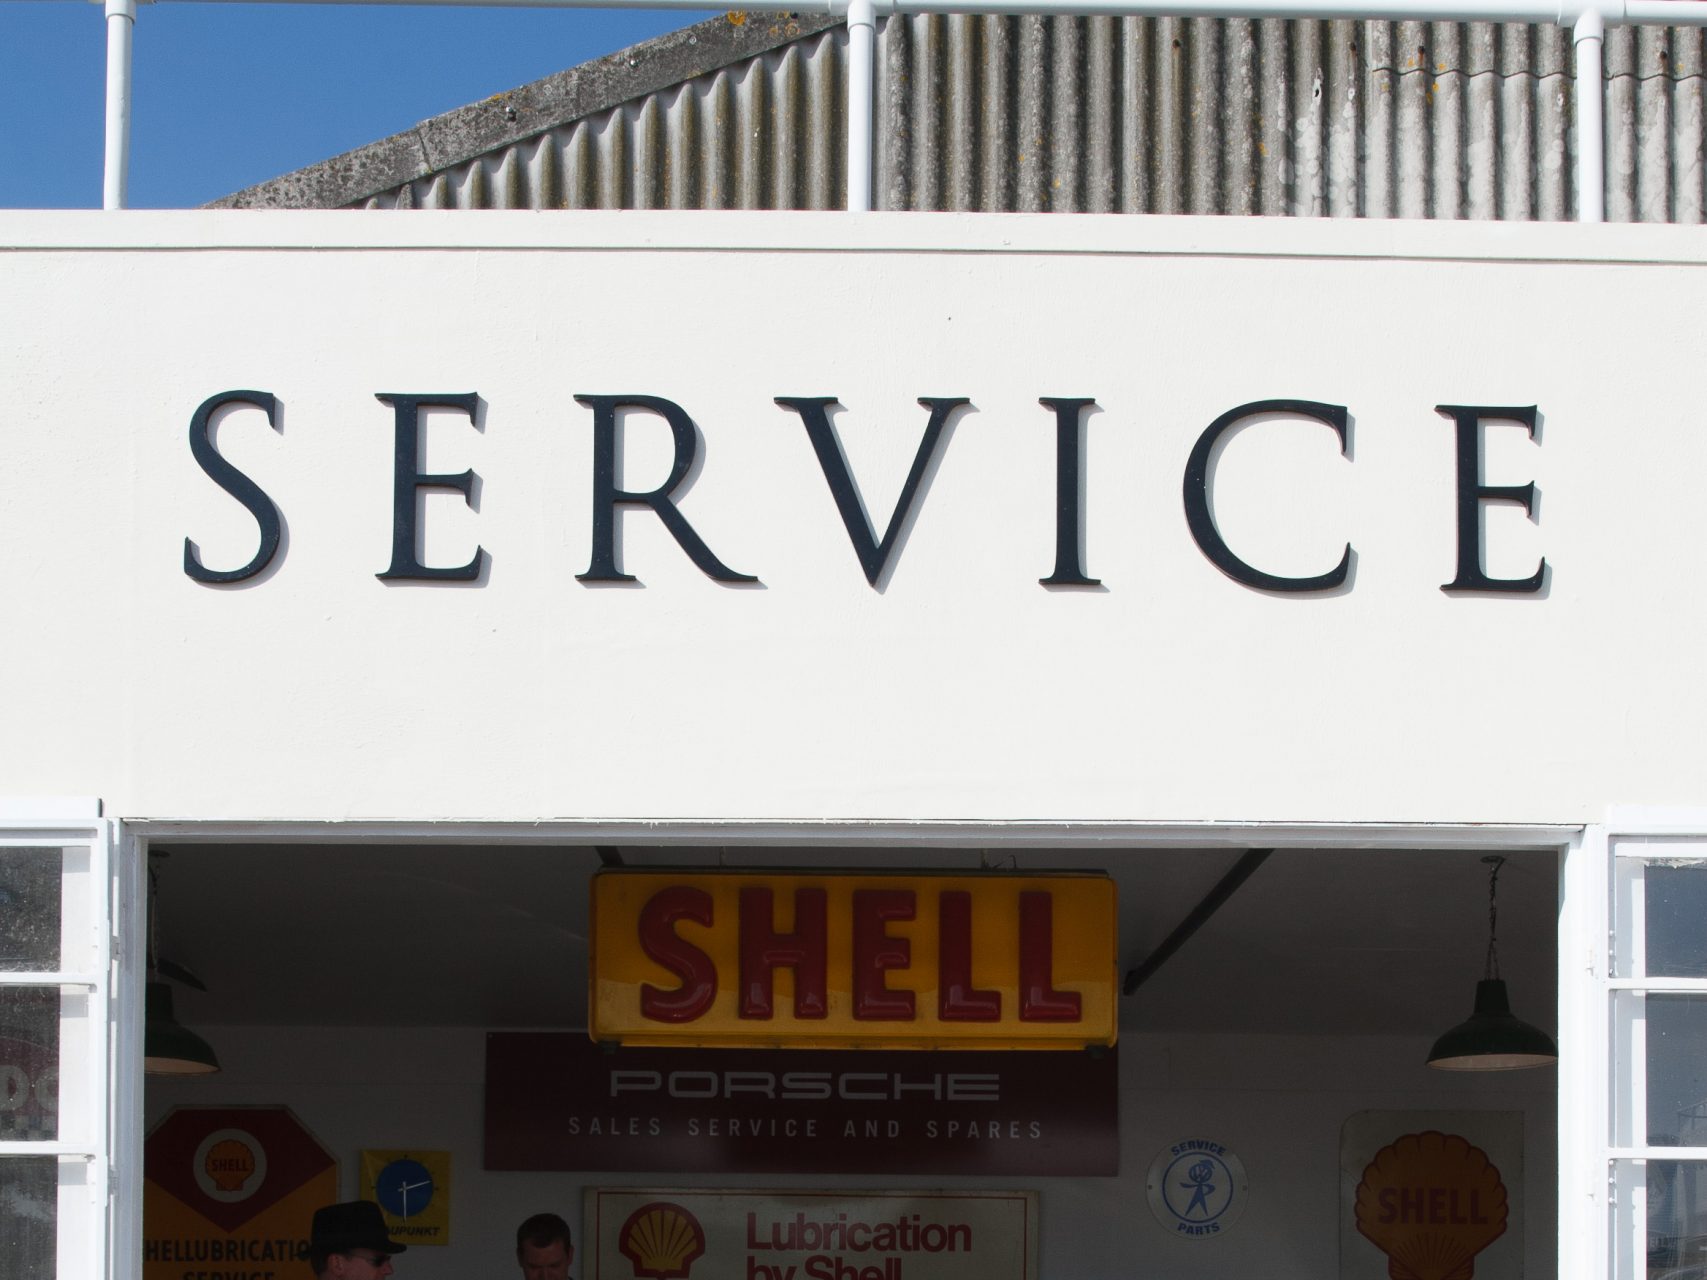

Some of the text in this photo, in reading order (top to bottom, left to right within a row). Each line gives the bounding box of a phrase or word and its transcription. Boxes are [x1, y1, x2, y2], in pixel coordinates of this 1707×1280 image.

[183, 389, 1549, 592] SERVICE
[638, 886, 1083, 1023] SHELL
[610, 1070, 1001, 1101] PORSCHE
[568, 1116, 1043, 1139] SALES SERVICE AND SPARES
[1171, 1139, 1227, 1156] SERVICE
[211, 1158, 249, 1173] SHELL
[1378, 1187, 1489, 1226] SHELL
[746, 1212, 972, 1253] Lubrication
[1177, 1222, 1221, 1236] PARTS
[145, 1239, 311, 1262] HELLUBRICATIO
